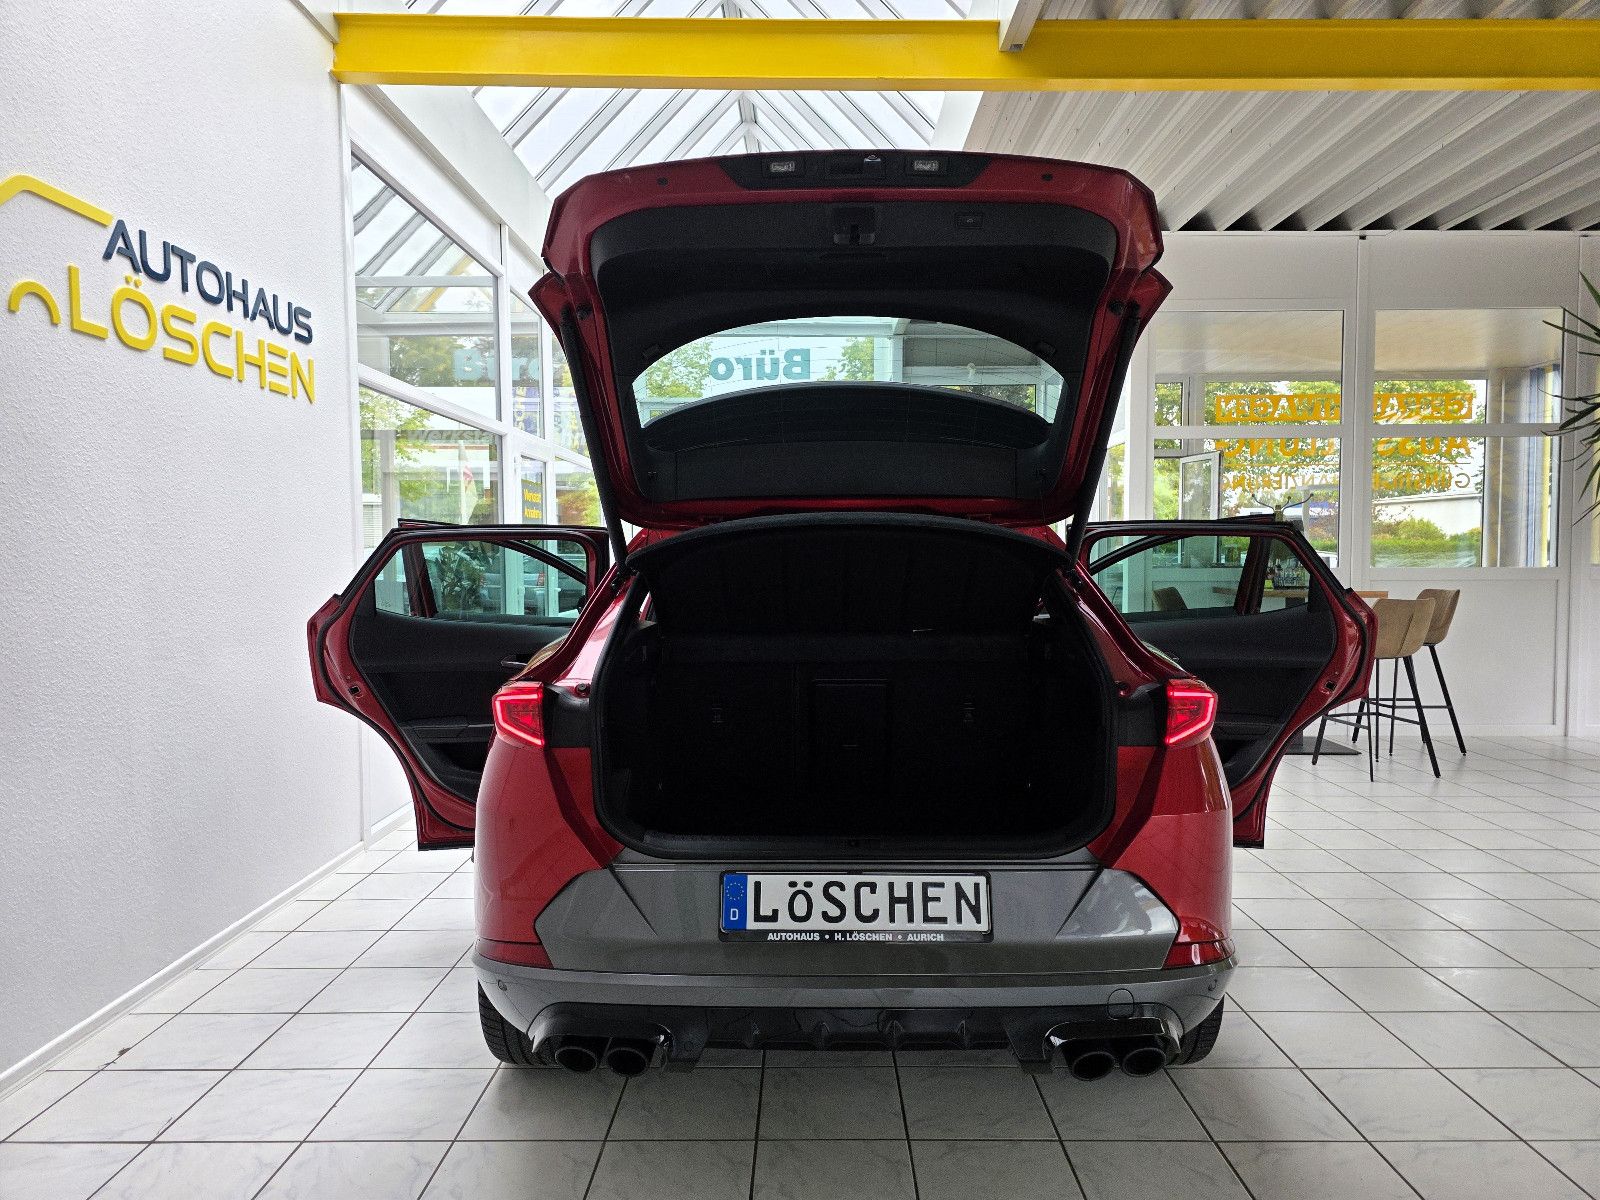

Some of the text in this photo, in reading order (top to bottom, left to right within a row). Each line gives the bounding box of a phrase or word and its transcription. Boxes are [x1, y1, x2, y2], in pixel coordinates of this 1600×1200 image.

[102, 219, 313, 344] AUTOHAUS
[67, 264, 316, 402] LÖSCHEN
[730, 908, 740, 921] D
[754, 881, 982, 924] LÖSCHEN
[766, 930, 945, 942] AUTOHAUS H. LÖSCHEN AURICH
